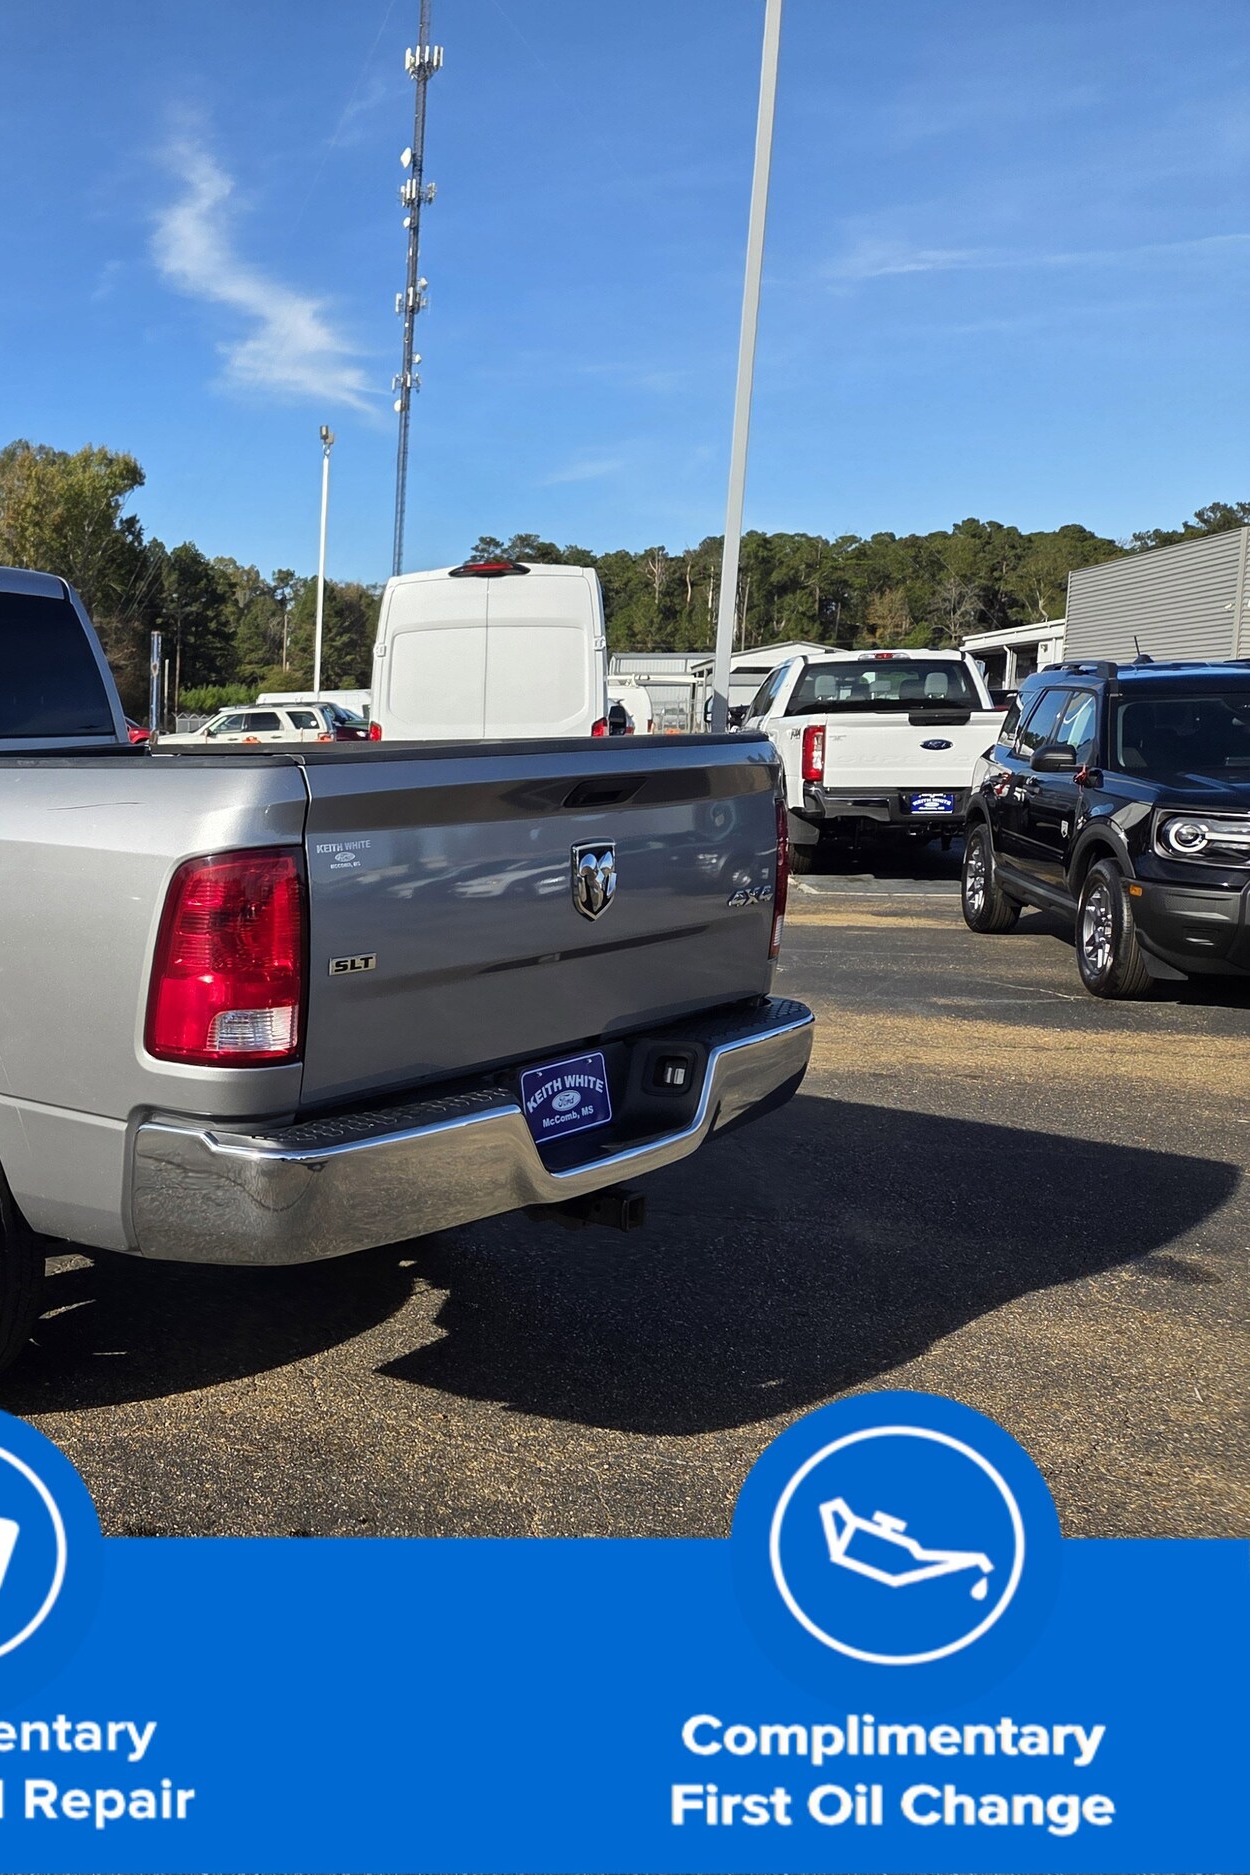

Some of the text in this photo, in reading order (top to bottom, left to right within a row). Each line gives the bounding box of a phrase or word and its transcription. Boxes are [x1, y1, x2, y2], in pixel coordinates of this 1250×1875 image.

[316, 839, 371, 854] KEITH WHITE
[334, 956, 373, 973] SLT
[526, 1074, 604, 1113] KEITH WHITE
[542, 1105, 594, 1128] McComb, MS
